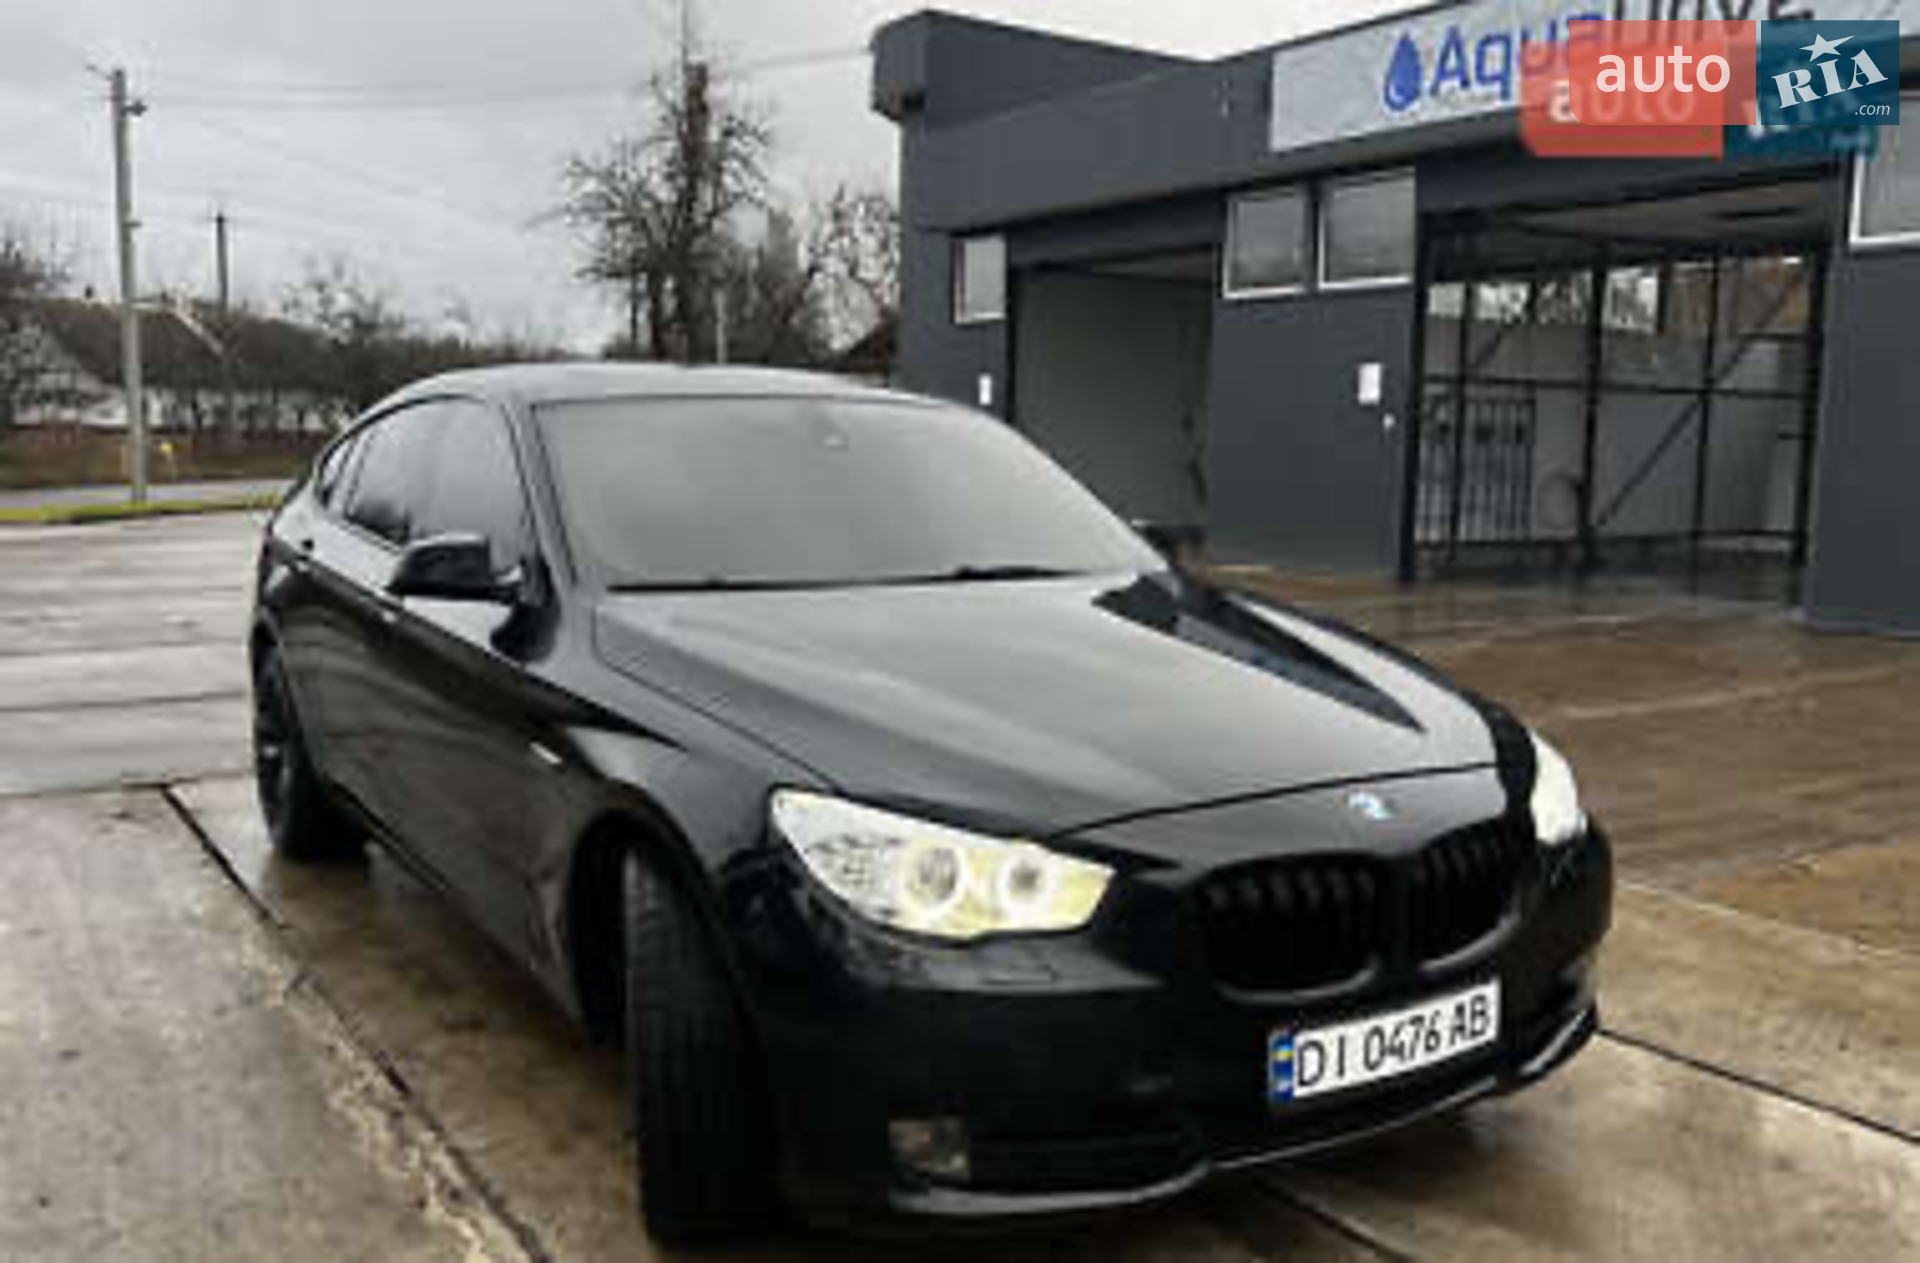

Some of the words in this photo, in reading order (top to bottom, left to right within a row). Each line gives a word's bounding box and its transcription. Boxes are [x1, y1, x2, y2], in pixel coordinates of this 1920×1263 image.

[1298, 1035, 1347, 1087] DI
[1363, 1009, 1443, 1072] 0476
[1449, 994, 1490, 1047] AB
